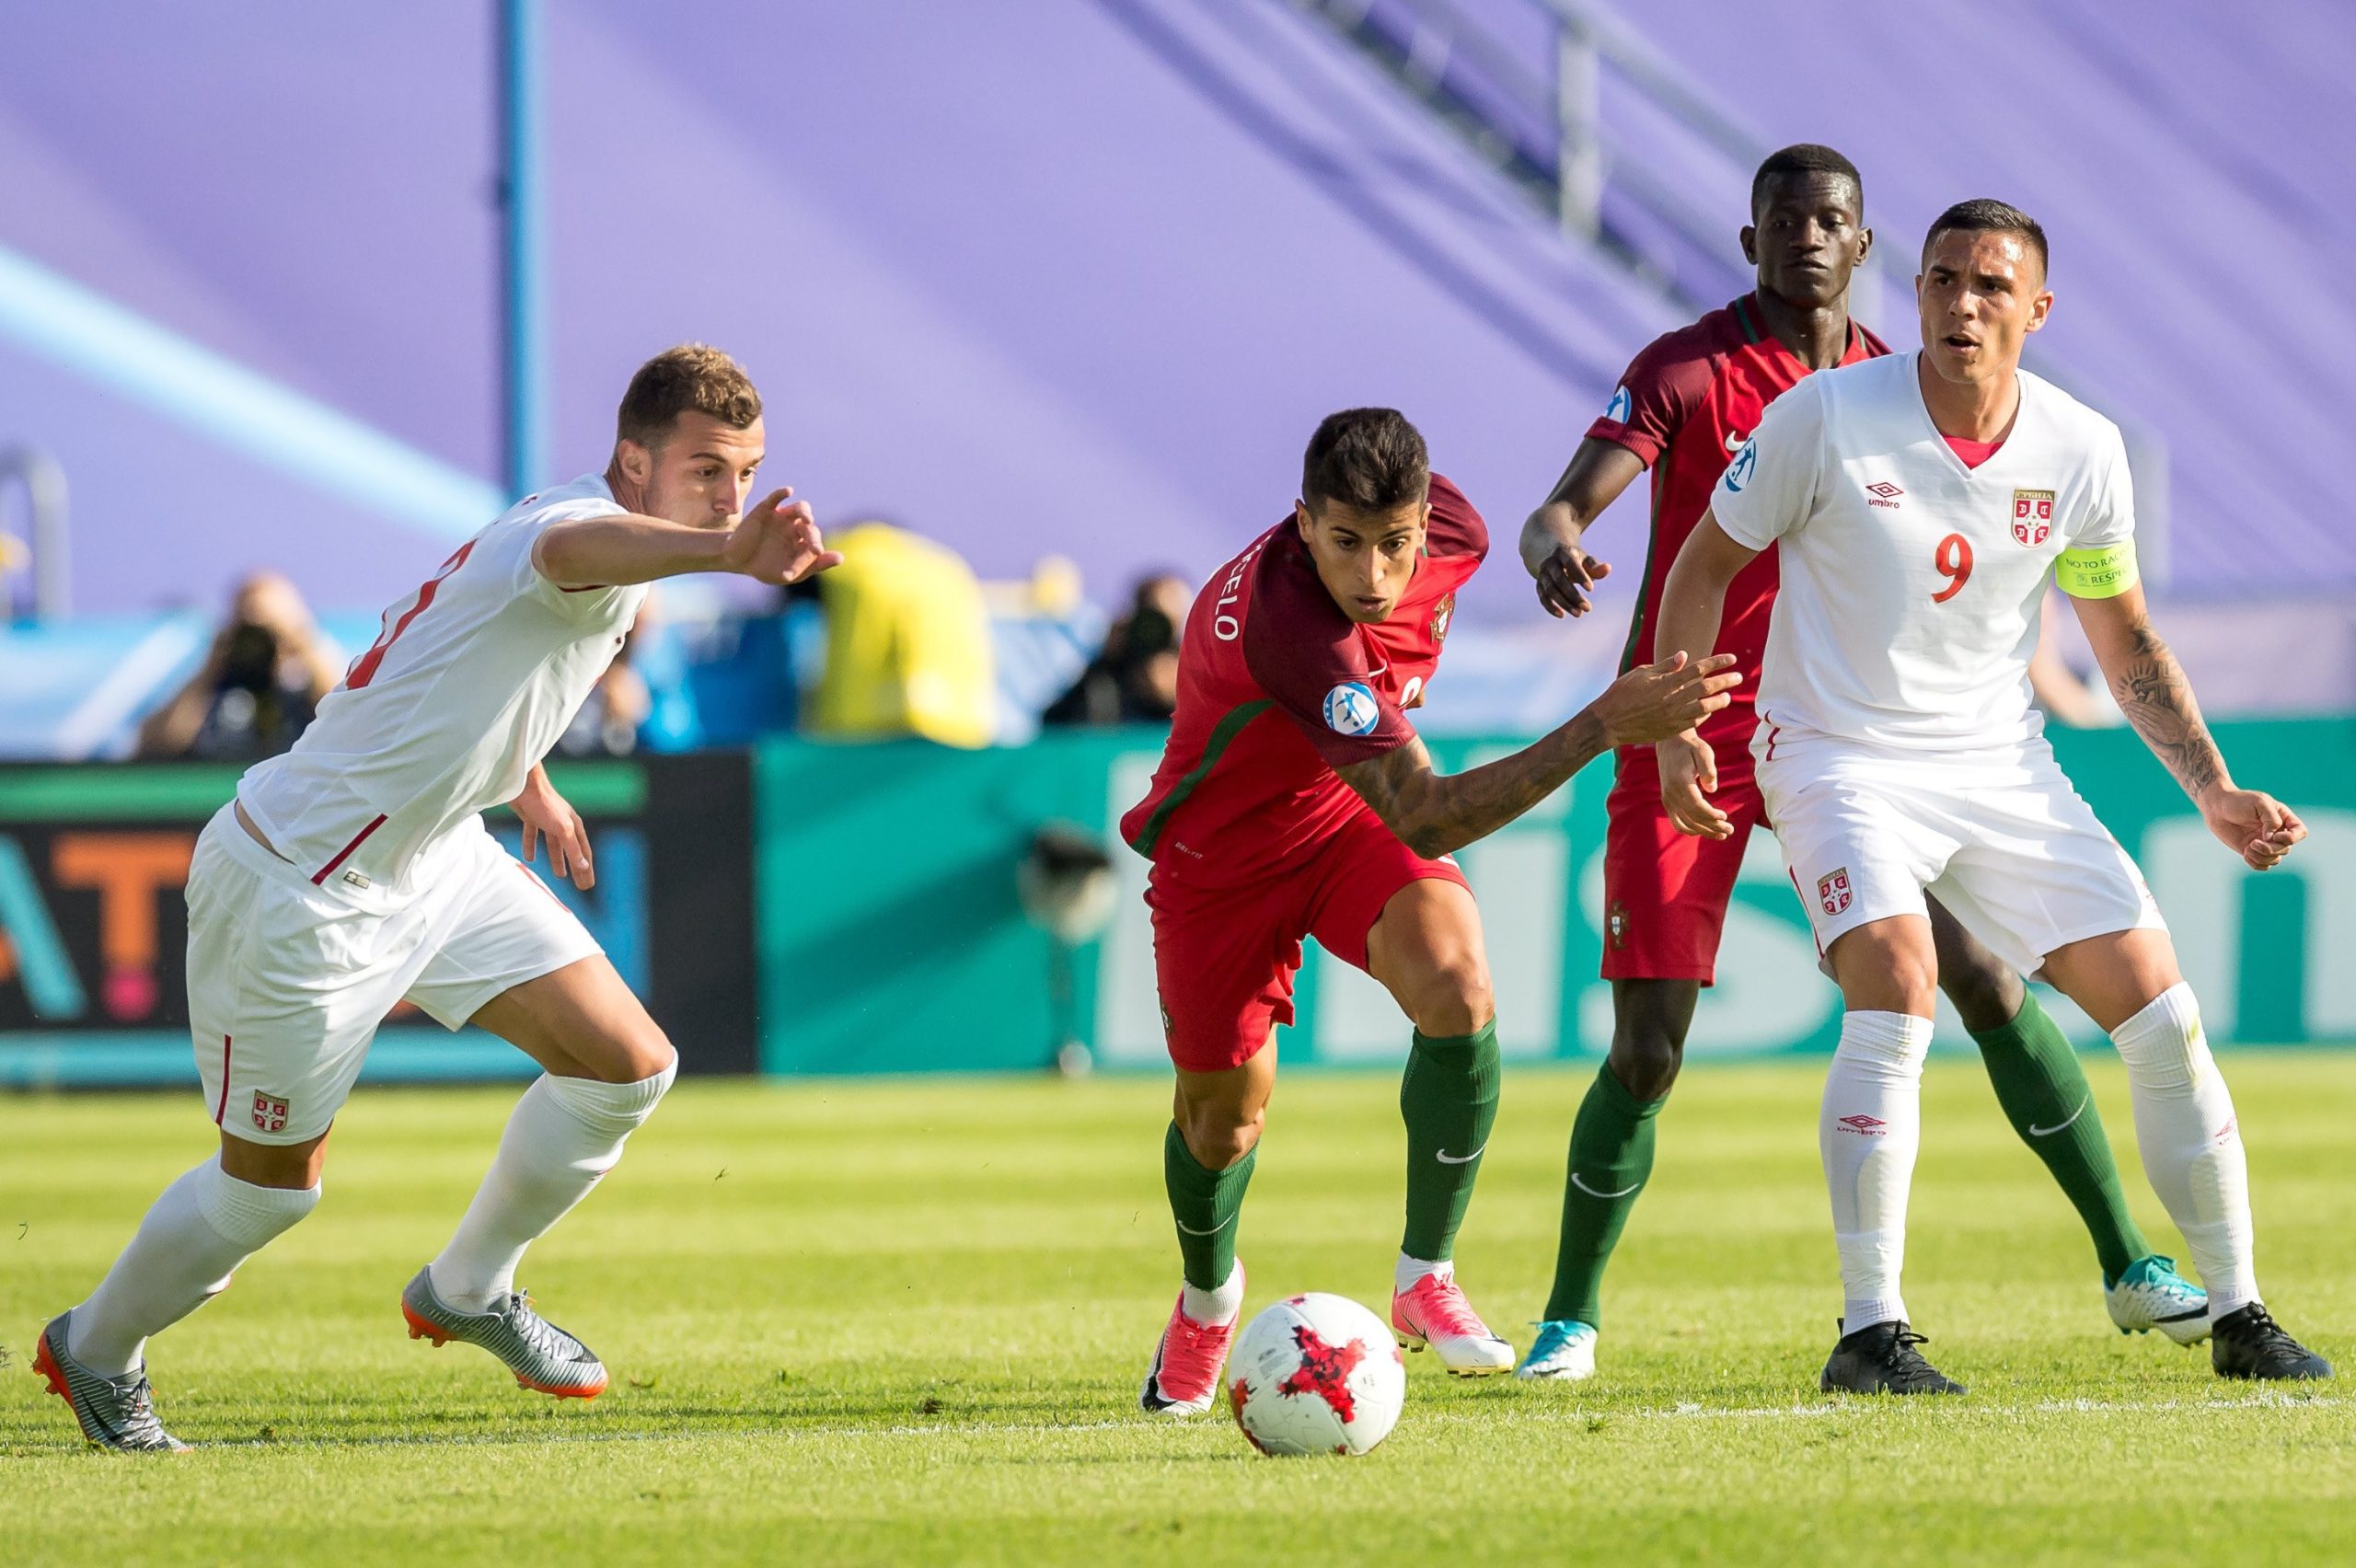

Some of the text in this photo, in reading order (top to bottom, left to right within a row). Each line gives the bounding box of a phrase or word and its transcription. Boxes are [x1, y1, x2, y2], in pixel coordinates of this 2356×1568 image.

[1868, 499, 1900, 509] umbro
[1931, 533, 1973, 604] 9
[2066, 558, 2081, 569] NO
[2083, 560, 2098, 570] TO
